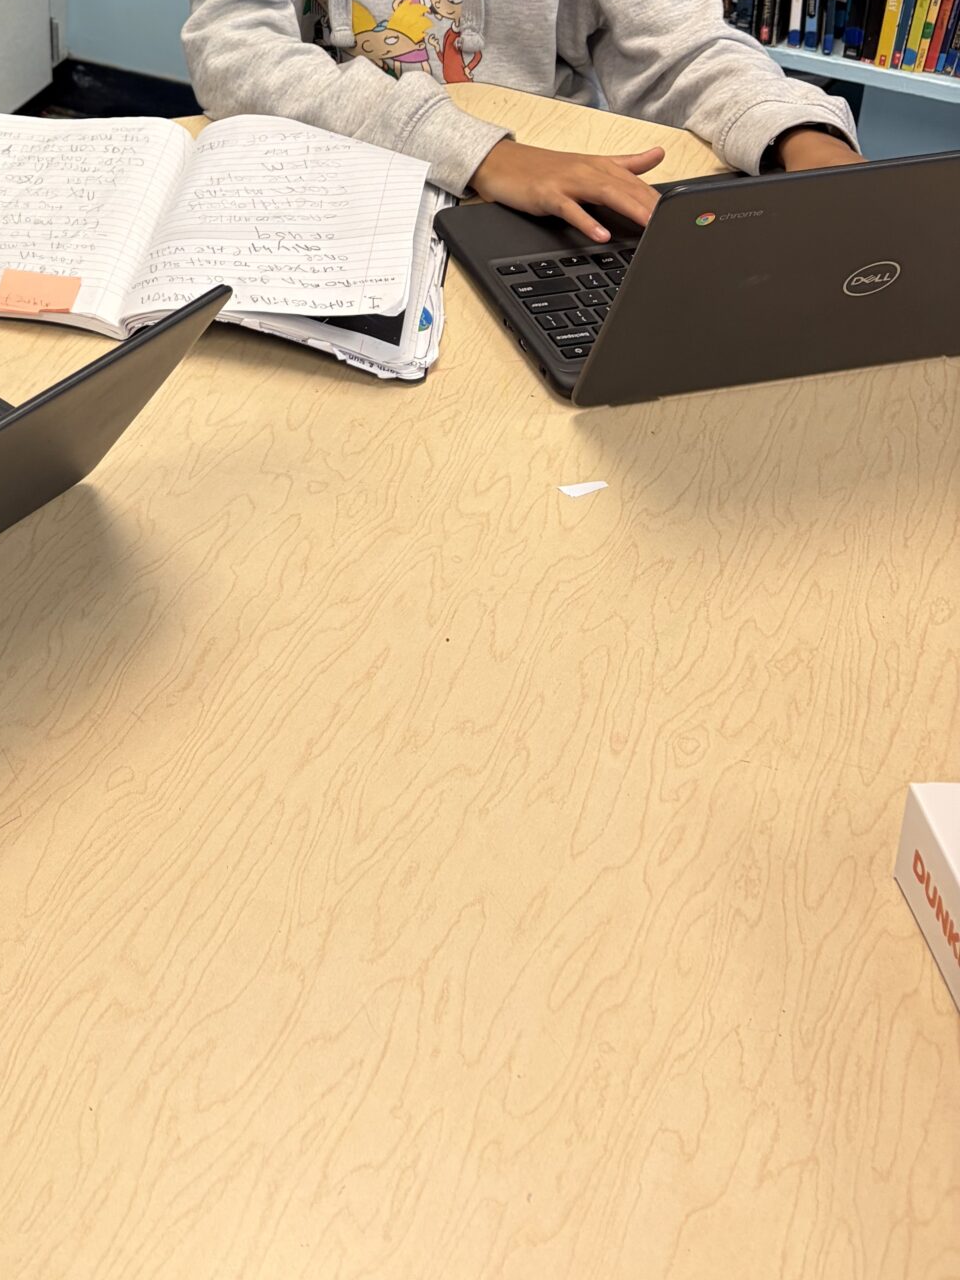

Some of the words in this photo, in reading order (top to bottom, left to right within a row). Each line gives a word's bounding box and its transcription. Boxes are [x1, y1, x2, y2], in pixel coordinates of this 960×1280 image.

[719, 208, 764, 221] chrome
[850, 272, 892, 288] DELL
[556, 332, 590, 340] backspace
